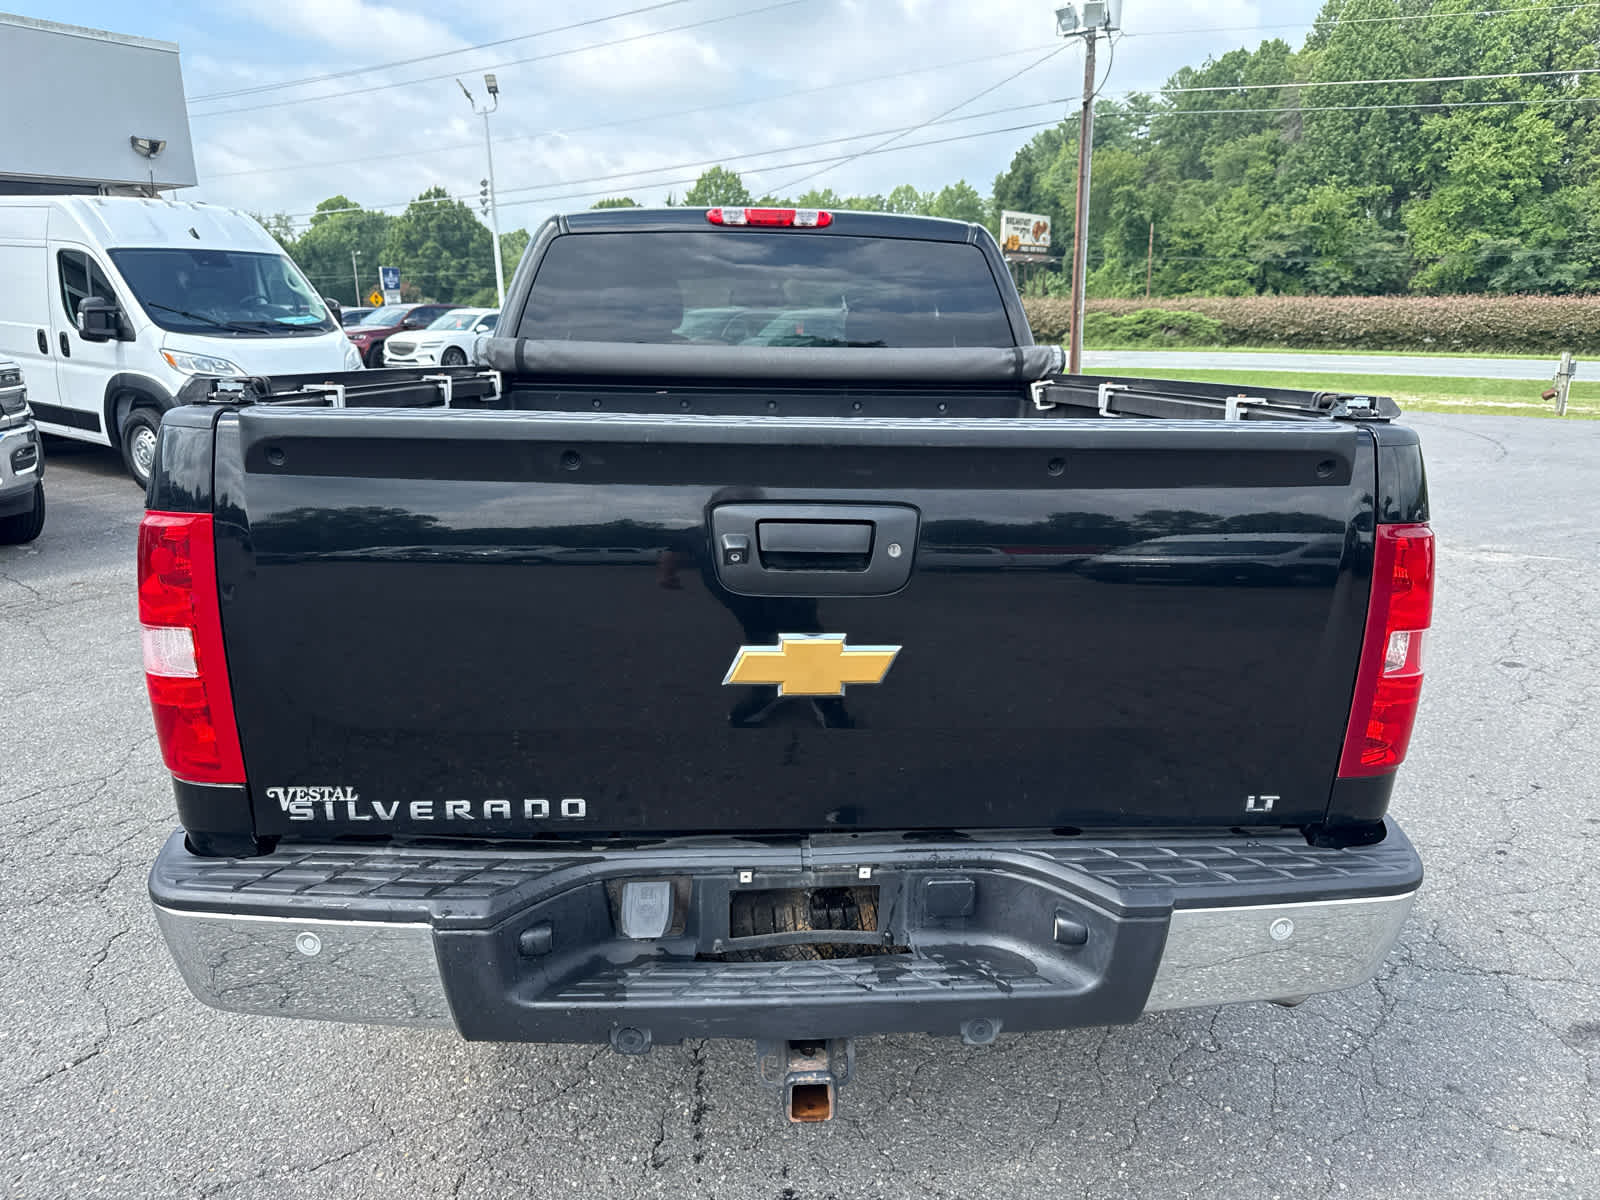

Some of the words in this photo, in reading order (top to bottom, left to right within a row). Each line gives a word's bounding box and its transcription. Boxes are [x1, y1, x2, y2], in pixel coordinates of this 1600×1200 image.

[266, 786, 359, 812] VESTAL
[288, 798, 586, 821] SILVERADO
[1245, 795, 1281, 813] LT
